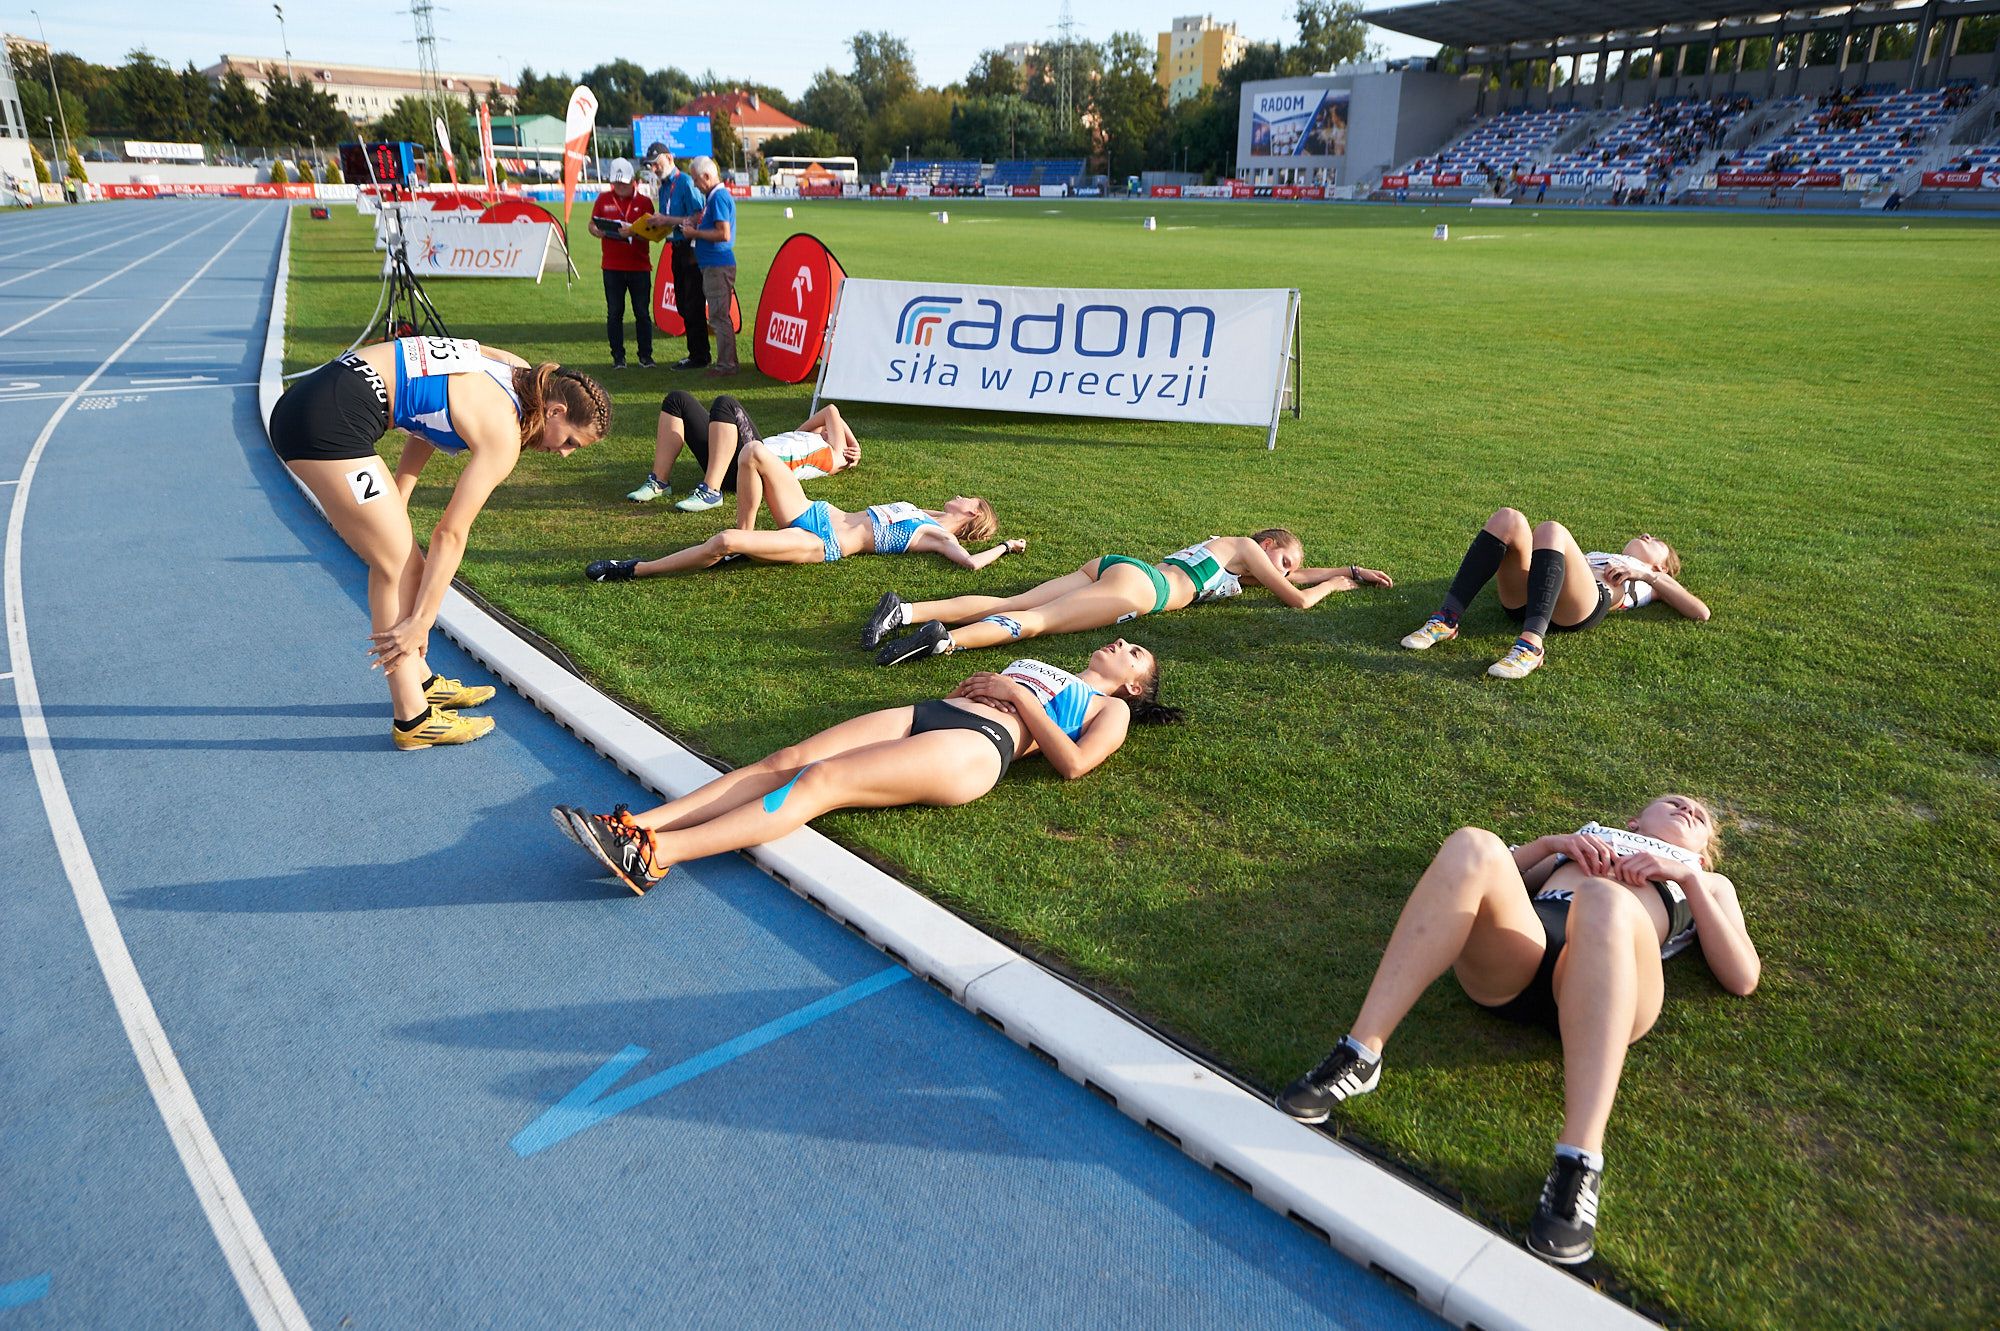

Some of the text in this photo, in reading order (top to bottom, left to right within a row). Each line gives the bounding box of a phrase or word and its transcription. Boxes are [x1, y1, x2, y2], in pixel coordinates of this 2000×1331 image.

[1261, 95, 1305, 113] RADOM
[137, 143, 192, 156] RADOM
[1560, 173, 1603, 185] RADM
[114, 186, 149, 196] PZLA
[245, 186, 278, 196] PZLA
[450, 242, 523, 268] mosir
[769, 317, 804, 349] ORLEN
[896, 296, 1216, 358] radom
[886, 353, 1209, 406] siła w precyzji
[356, 471, 381, 500] 2
